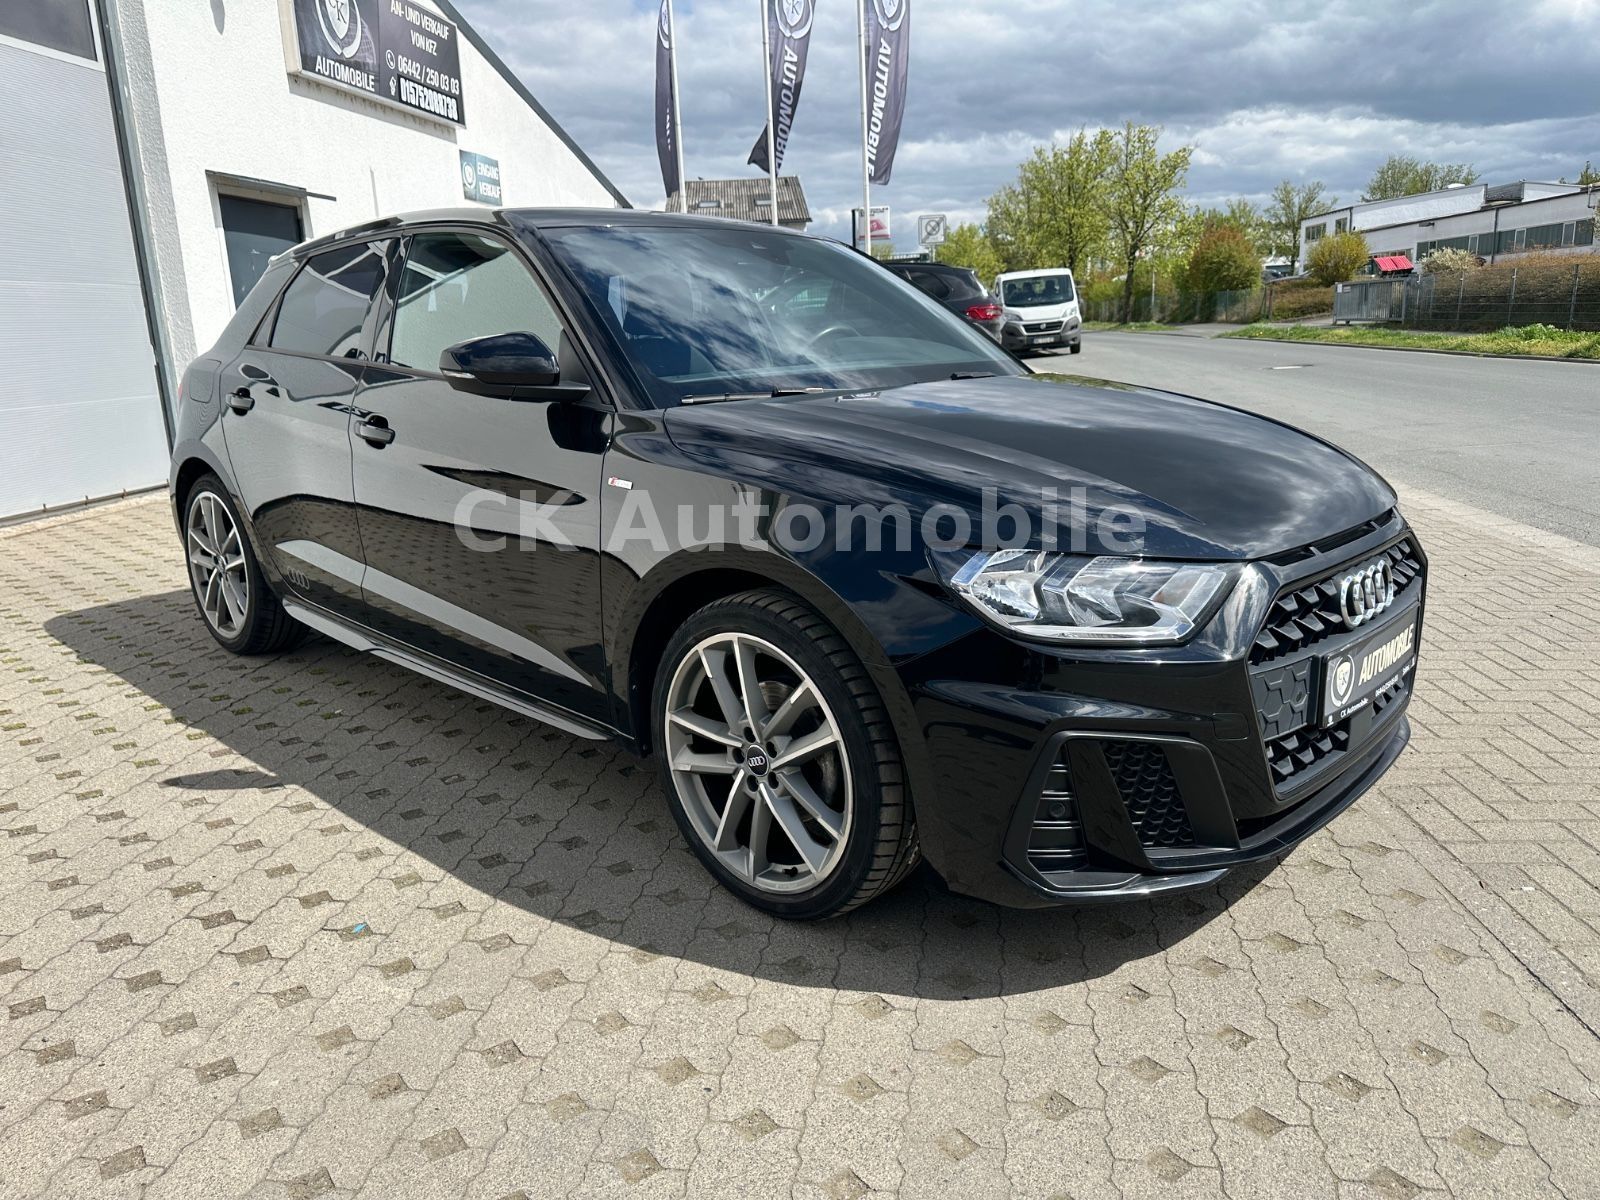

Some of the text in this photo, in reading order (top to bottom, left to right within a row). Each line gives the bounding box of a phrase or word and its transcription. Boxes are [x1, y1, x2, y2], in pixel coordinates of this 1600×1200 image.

[390, 0, 450, 40] AN- UND VERKAUF
[410, 30, 437, 56] VON KFZ
[315, 54, 375, 92] AUTOMOBILE
[398, 54, 460, 95] 06442 / 250 03 03
[479, 181, 501, 199] VERKAUF
[1358, 623, 1414, 687] AUTOMOBILE
